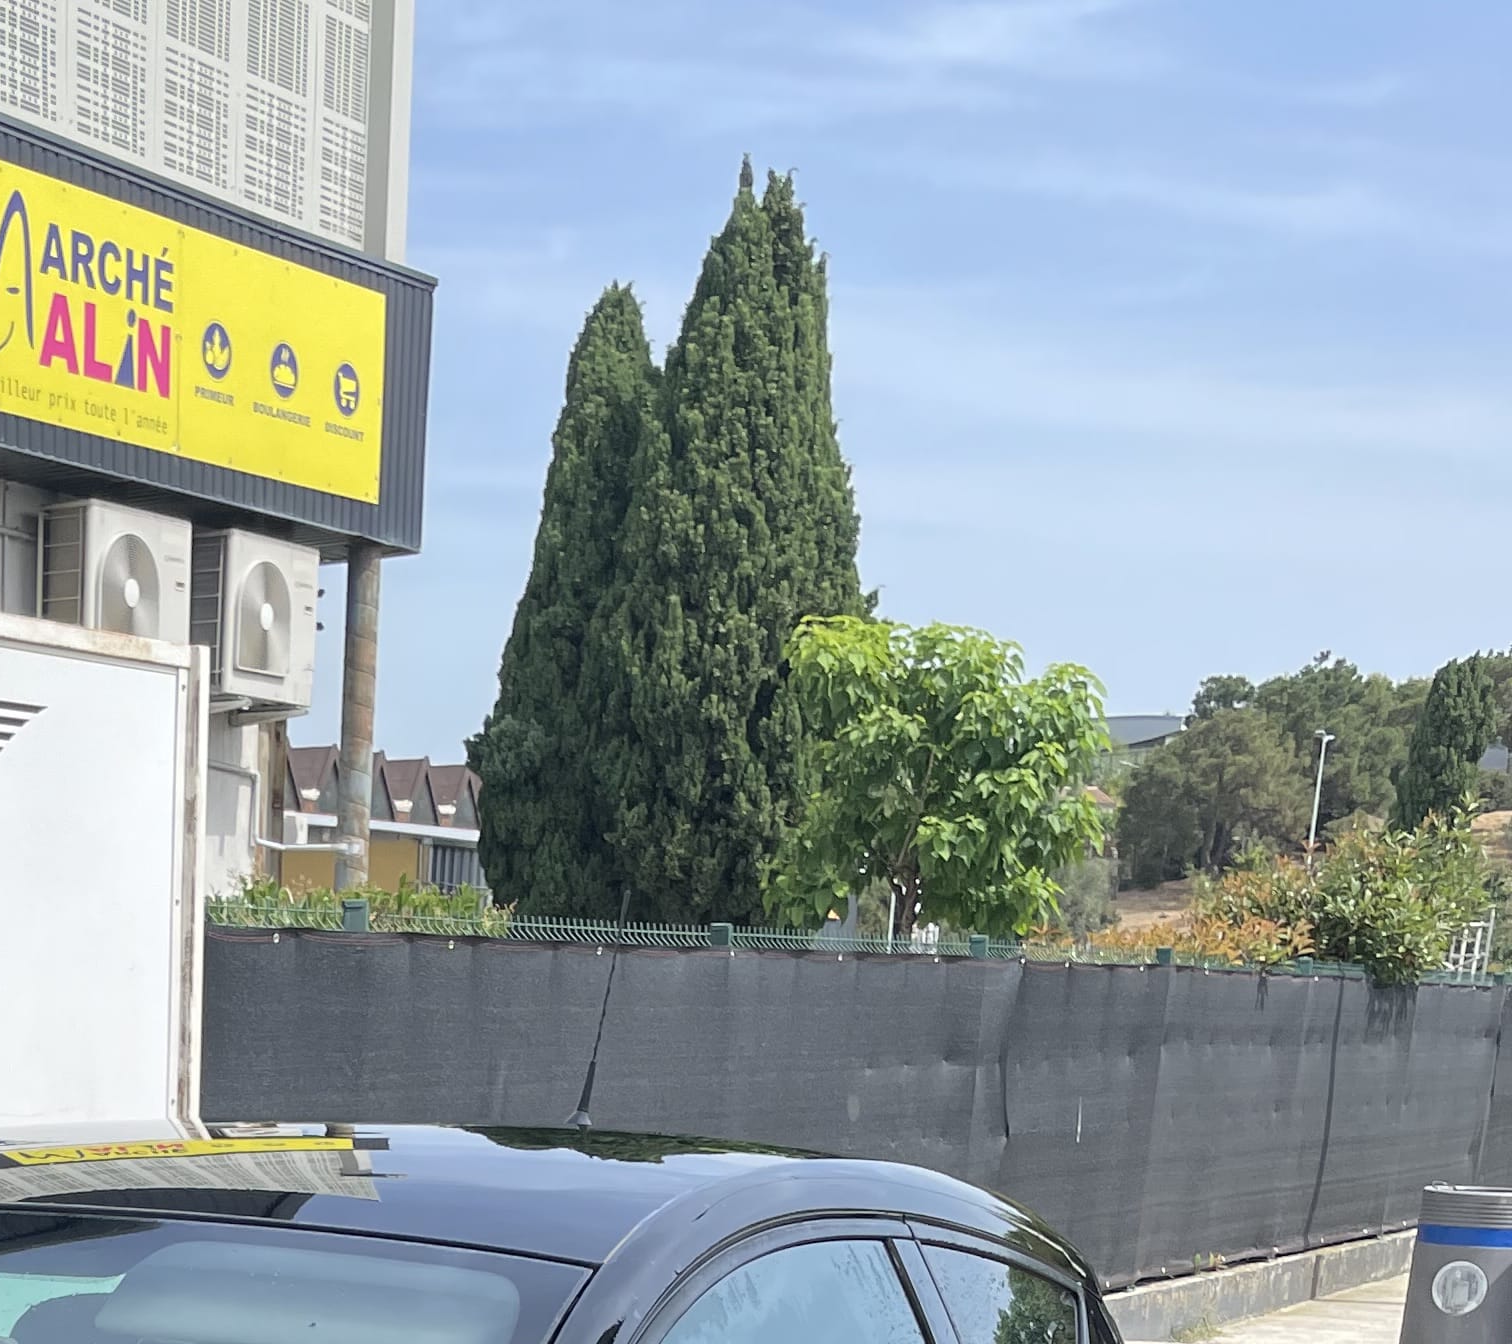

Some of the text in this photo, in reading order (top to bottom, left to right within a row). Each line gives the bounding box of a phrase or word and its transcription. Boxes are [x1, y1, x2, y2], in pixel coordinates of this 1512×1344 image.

[49, 391, 77, 411] prix
[84, 399, 117, 423] toute
[194, 386, 235, 406] PRIMEUR
[252, 401, 311, 428] BOULANGERIE
[324, 422, 365, 443] DISCOUNT
